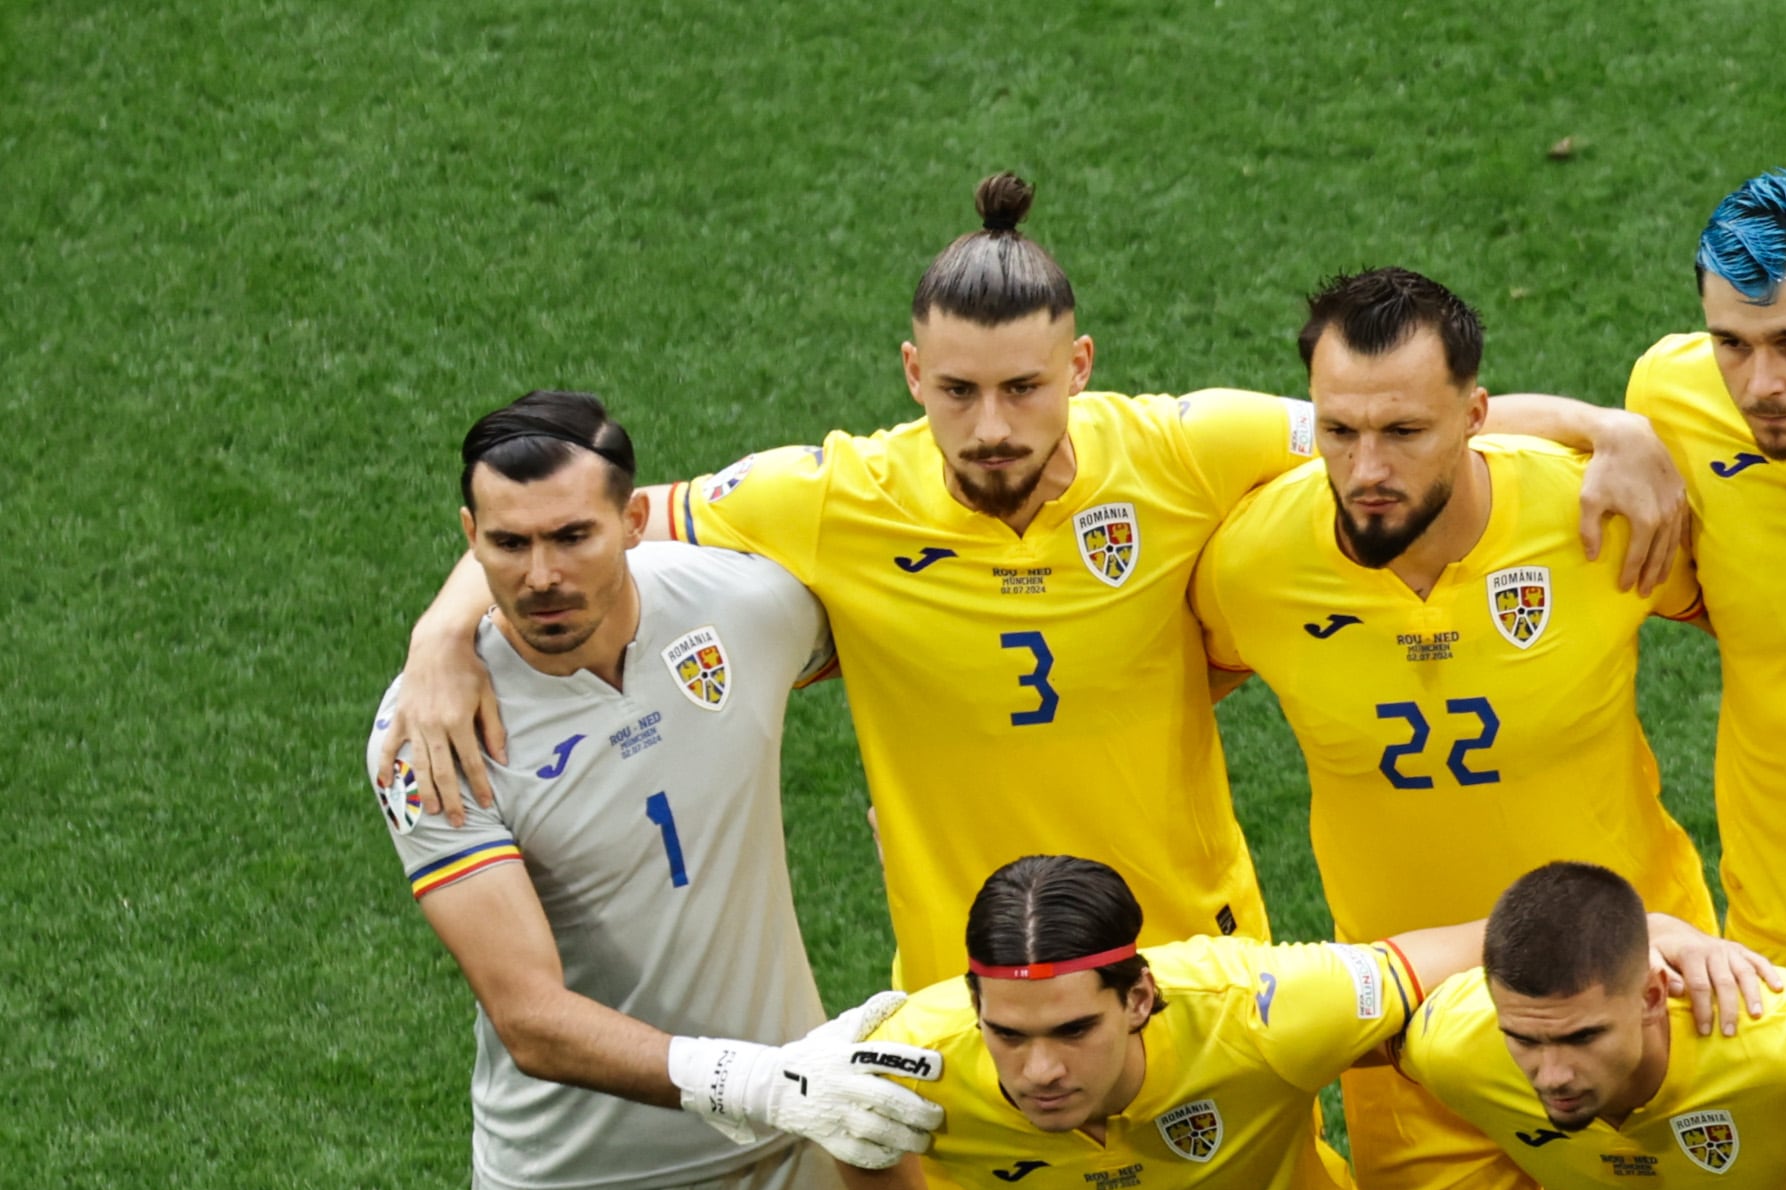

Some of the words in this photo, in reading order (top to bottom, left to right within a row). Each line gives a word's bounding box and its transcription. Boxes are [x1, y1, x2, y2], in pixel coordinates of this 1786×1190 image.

[1079, 506, 1129, 529] ROMÂNIA
[1494, 569, 1544, 589] ROMÂNIA
[668, 631, 713, 662] ROMÂNIA
[1397, 634, 1422, 645] ROU
[1434, 631, 1459, 643] NED
[1000, 631, 1059, 726] 3
[609, 726, 632, 746] ROU
[638, 711, 662, 731] NED
[1375, 696, 1501, 789] 22
[645, 790, 691, 889] 1
[851, 1050, 932, 1077] reusch
[1162, 1102, 1211, 1126] ROMÂNIA
[1676, 1112, 1726, 1130] ROMÂNIA
